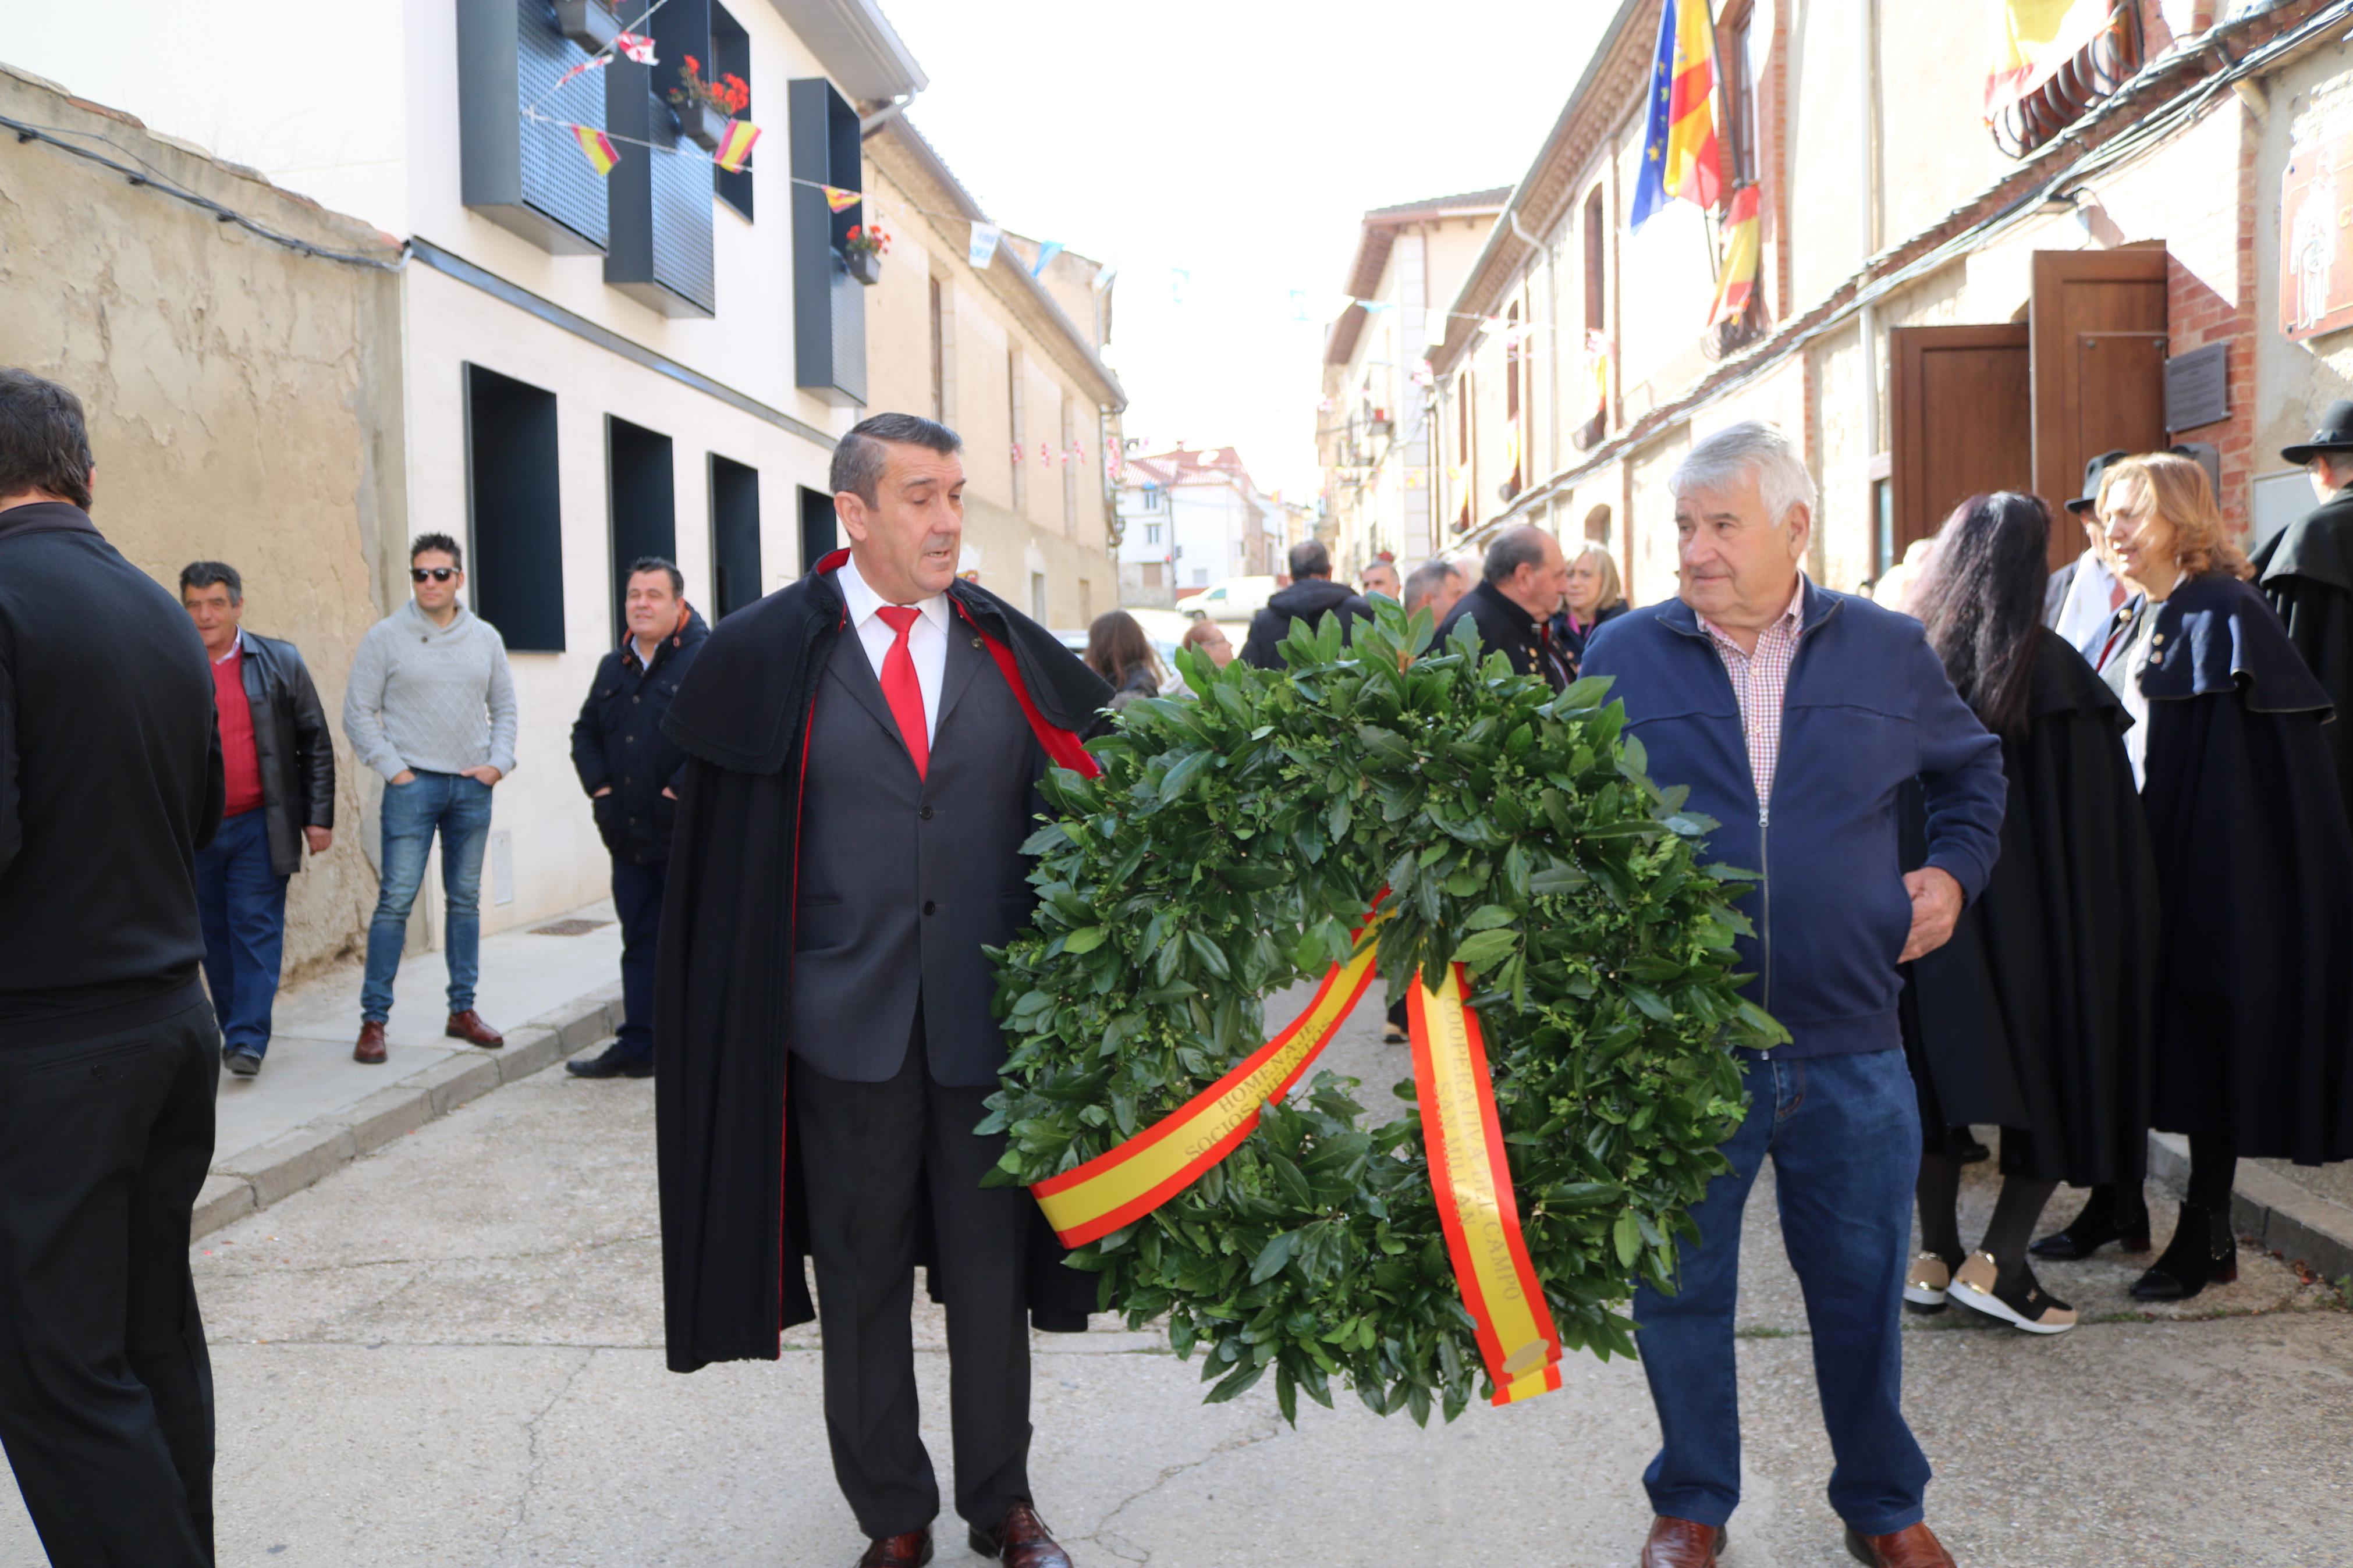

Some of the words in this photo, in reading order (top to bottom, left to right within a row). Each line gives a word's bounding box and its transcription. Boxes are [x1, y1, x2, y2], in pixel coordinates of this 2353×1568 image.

[1184, 1103, 1254, 1158] SOCIOS
[1256, 1017, 1332, 1103] DIFUNTOS
[1218, 1021, 1315, 1114] HOMENAJE
[1433, 1081, 1457, 1129] SAN
[1443, 997, 1486, 1162] COOPERATIVA
[1442, 1136, 1476, 1226] MILLAN
[1472, 1169, 1496, 1215] DEL
[1483, 1221, 1521, 1300] CAMPO
